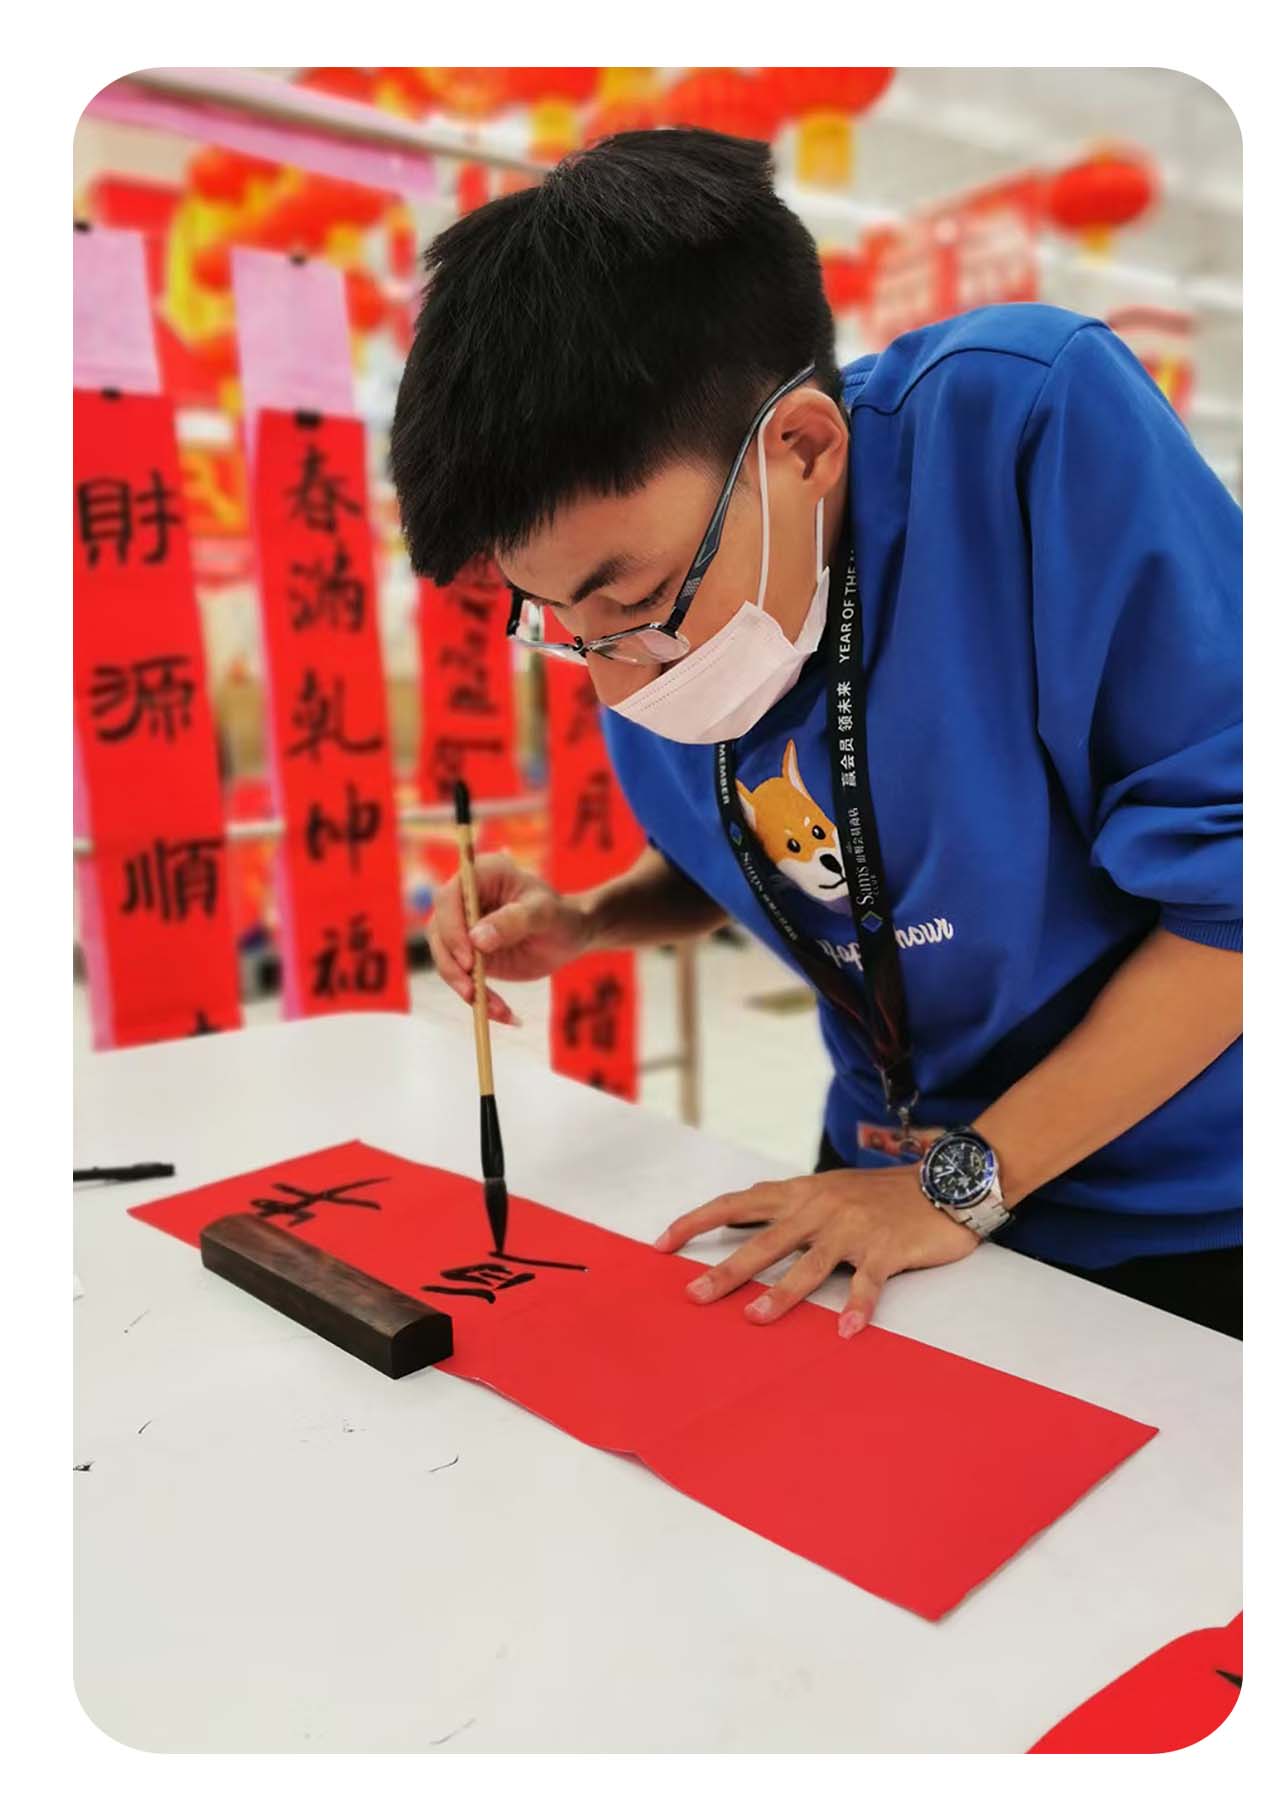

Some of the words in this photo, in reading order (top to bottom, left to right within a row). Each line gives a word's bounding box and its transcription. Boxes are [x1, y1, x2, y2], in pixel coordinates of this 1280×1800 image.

[841, 601, 855, 619] OF
[838, 622, 852, 664] YEAR
[78, 470, 226, 1036] 財源順
